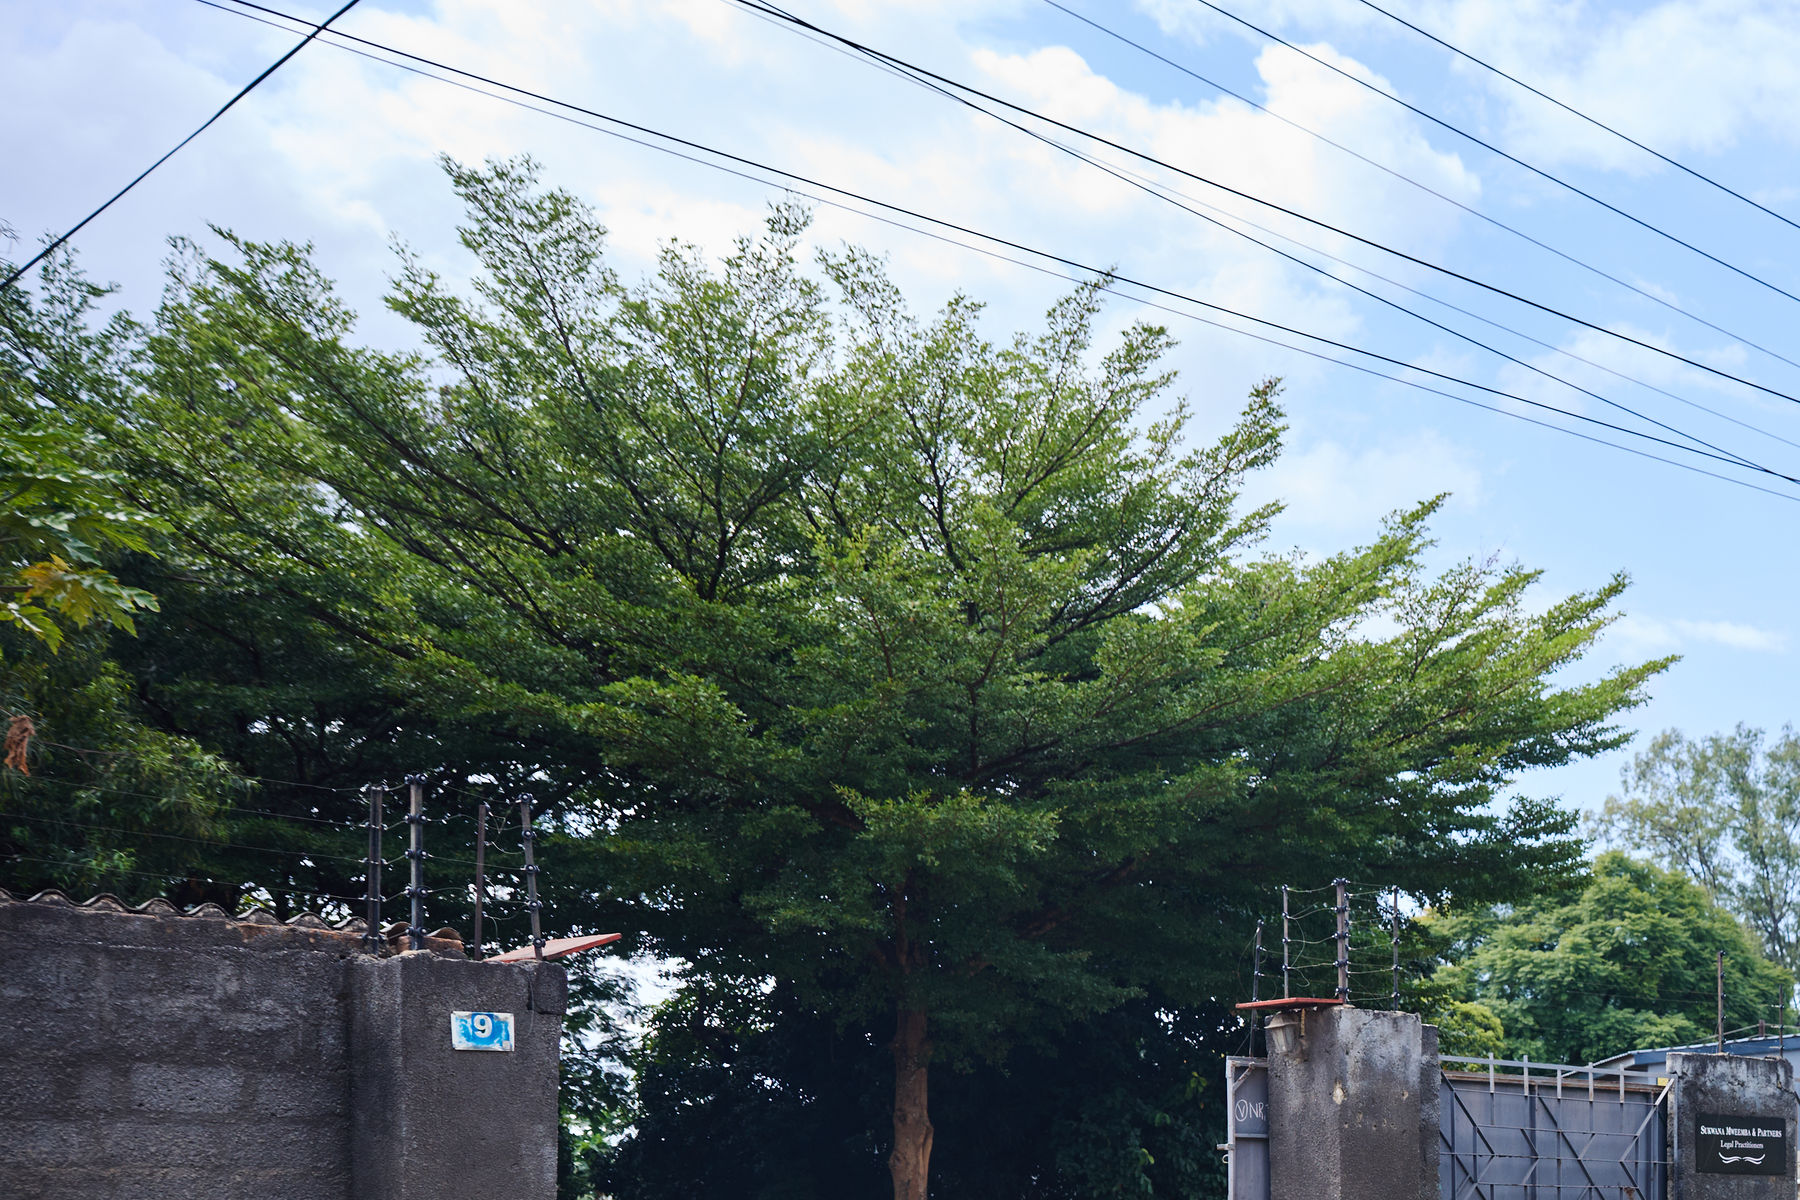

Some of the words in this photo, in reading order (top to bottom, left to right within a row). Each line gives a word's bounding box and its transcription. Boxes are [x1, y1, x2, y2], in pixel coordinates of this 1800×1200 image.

[473, 1014, 493, 1038] 9
[1700, 1125, 1725, 1136] SUKWANA
[1726, 1126, 1751, 1137] MWEEMBA
[1752, 1127, 1757, 1137] &
[1757, 1128, 1782, 1138] PARTNERS
[1720, 1140, 1734, 1149] Legal
[1735, 1140, 1764, 1149] Practitioners
